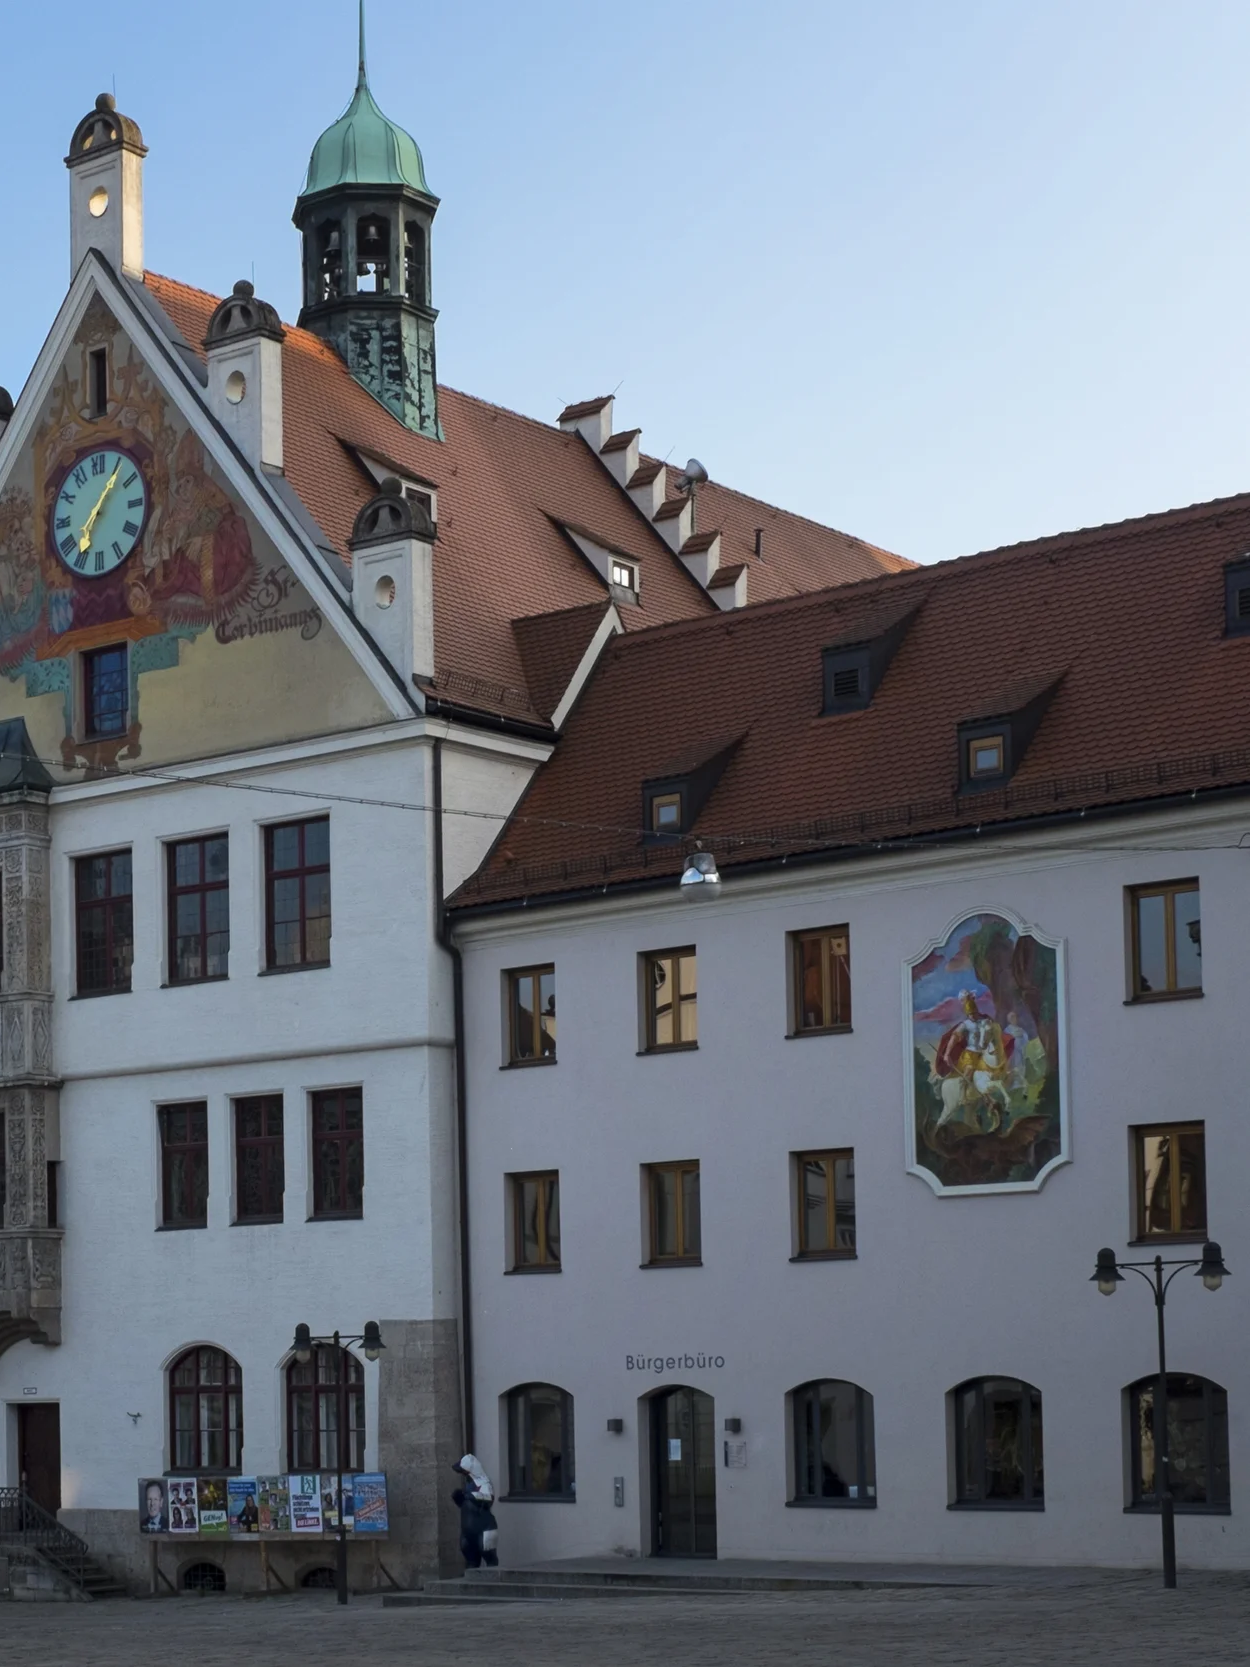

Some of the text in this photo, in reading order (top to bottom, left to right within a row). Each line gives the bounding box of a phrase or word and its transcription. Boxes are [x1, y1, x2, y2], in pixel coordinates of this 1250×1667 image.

[91, 454, 105, 477] XII
[73, 465, 88, 489] XI
[123, 471, 138, 489] II
[60, 490, 76, 505] X
[127, 497, 143, 509] III
[55, 515, 71, 530] IX
[60, 533, 77, 557] VIII
[111, 541, 124, 560] V
[94, 551, 105, 572] VI
[625, 1352, 725, 1374] Bürgerbüro
